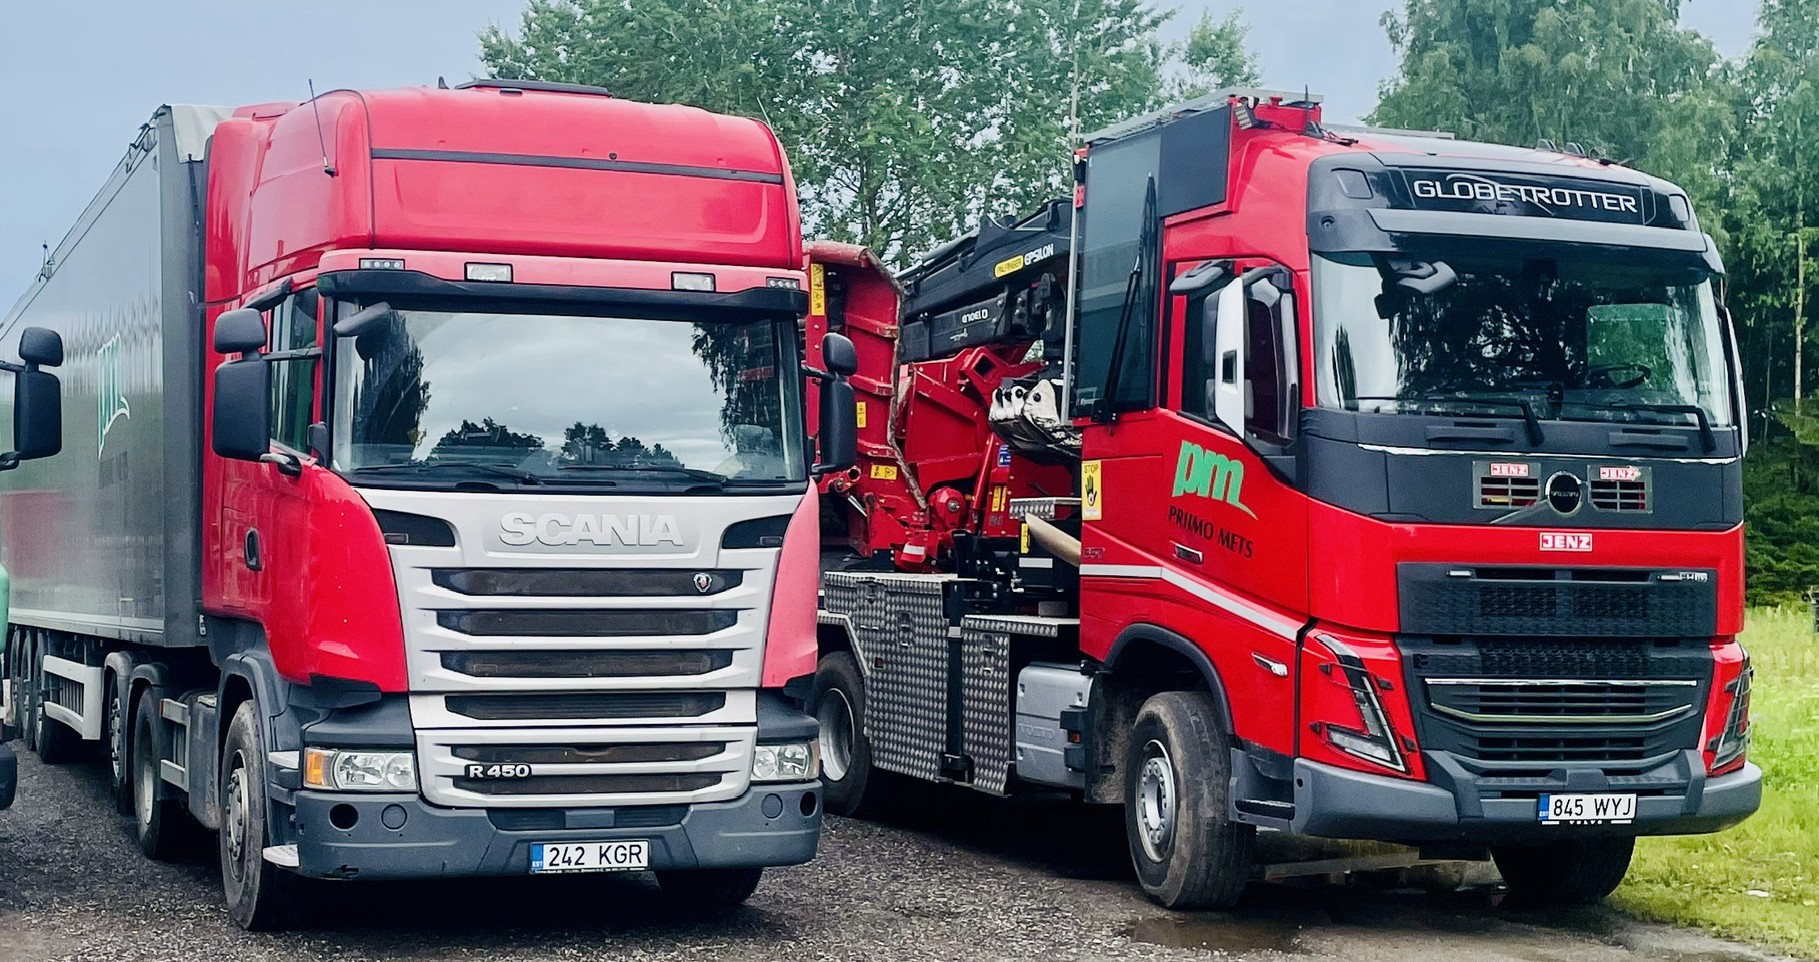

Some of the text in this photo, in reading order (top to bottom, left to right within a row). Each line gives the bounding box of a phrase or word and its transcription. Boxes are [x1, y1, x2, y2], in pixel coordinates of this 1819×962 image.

[1413, 180, 1638, 213] GLOBETROTTER
[1024, 243, 1054, 266] EPSILON
[1084, 464, 1099, 474] STOP
[1492, 464, 1528, 475] JENZ
[1601, 469, 1635, 479] JENZ
[1172, 440, 1258, 520] pm
[499, 512, 685, 546] SCANIA
[1169, 505, 1254, 559] PRIIMO METS
[1542, 535, 1591, 549] JENZ
[469, 764, 530, 778] R 450
[1553, 798, 1584, 817] 845
[1594, 798, 1632, 816] WYJ
[548, 846, 586, 867] 242
[599, 844, 642, 865] KGR
